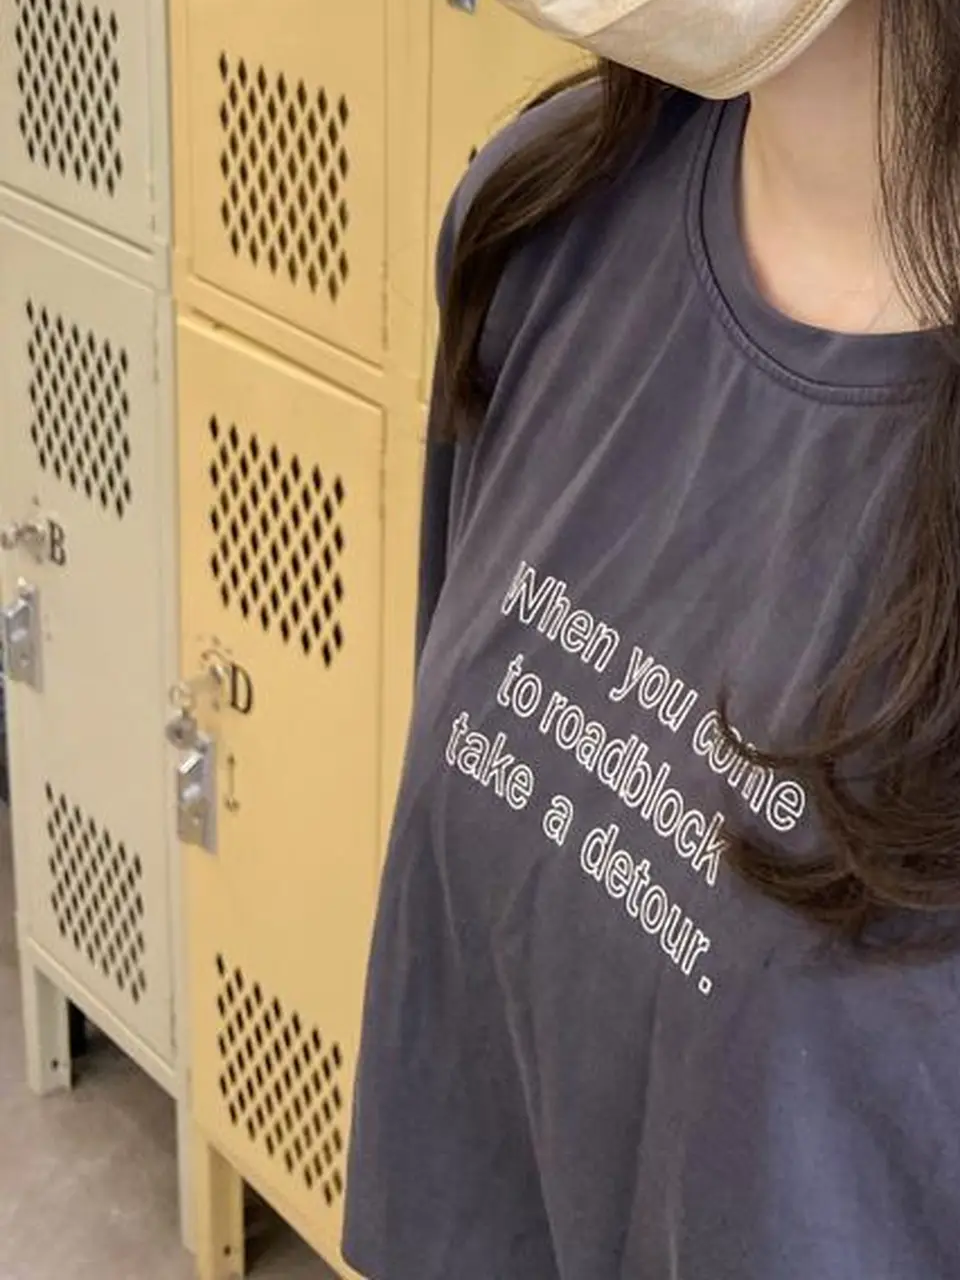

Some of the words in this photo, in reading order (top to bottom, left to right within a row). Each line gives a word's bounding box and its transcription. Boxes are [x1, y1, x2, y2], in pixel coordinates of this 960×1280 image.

[49, 520, 66, 566] B
[229, 662, 252, 714] D
[501, 561, 620, 673] When
[609, 646, 697, 732] you
[445, 712, 534, 809] take
[542, 794, 574, 846] a
[497, 654, 542, 717] to
[539, 692, 729, 886] roadblock
